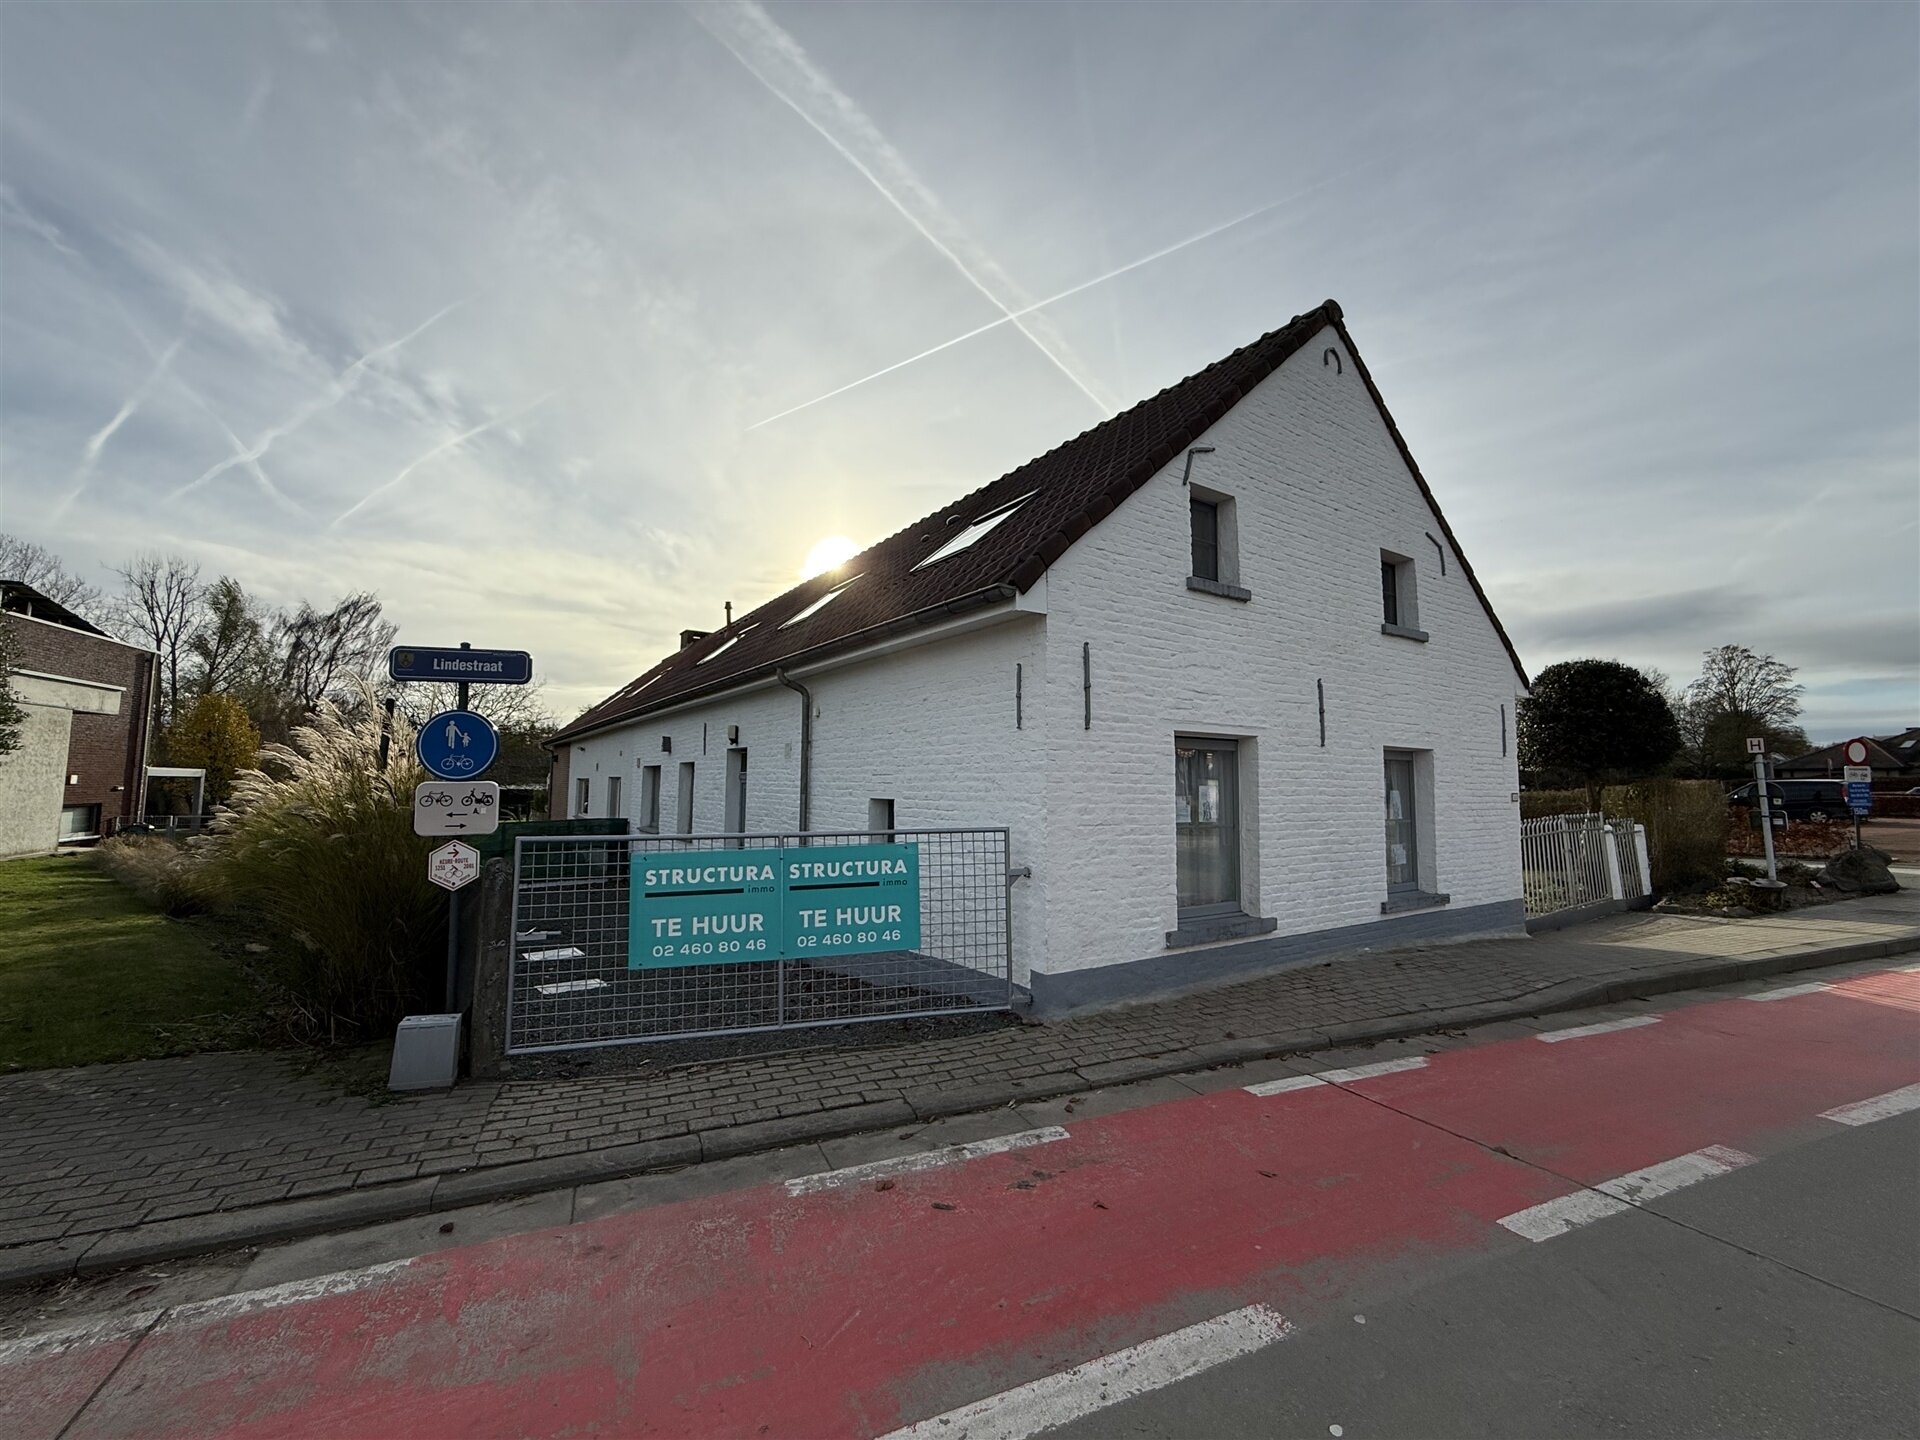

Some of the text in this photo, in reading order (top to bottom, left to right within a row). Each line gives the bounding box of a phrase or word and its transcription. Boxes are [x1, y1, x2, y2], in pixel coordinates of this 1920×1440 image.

[433, 658, 503, 672] Lindestraat
[1750, 740, 1761, 751] H
[645, 864, 775, 886] STRUCTURA
[789, 859, 908, 880] STRUCTURA
[747, 884, 775, 894] immo
[882, 877, 908, 887] immo
[651, 913, 764, 938] TE HUUR
[799, 905, 901, 928] TE HUUR
[797, 929, 901, 947] 02 460 80 46
[652, 939, 767, 957] 02 460 80 46
